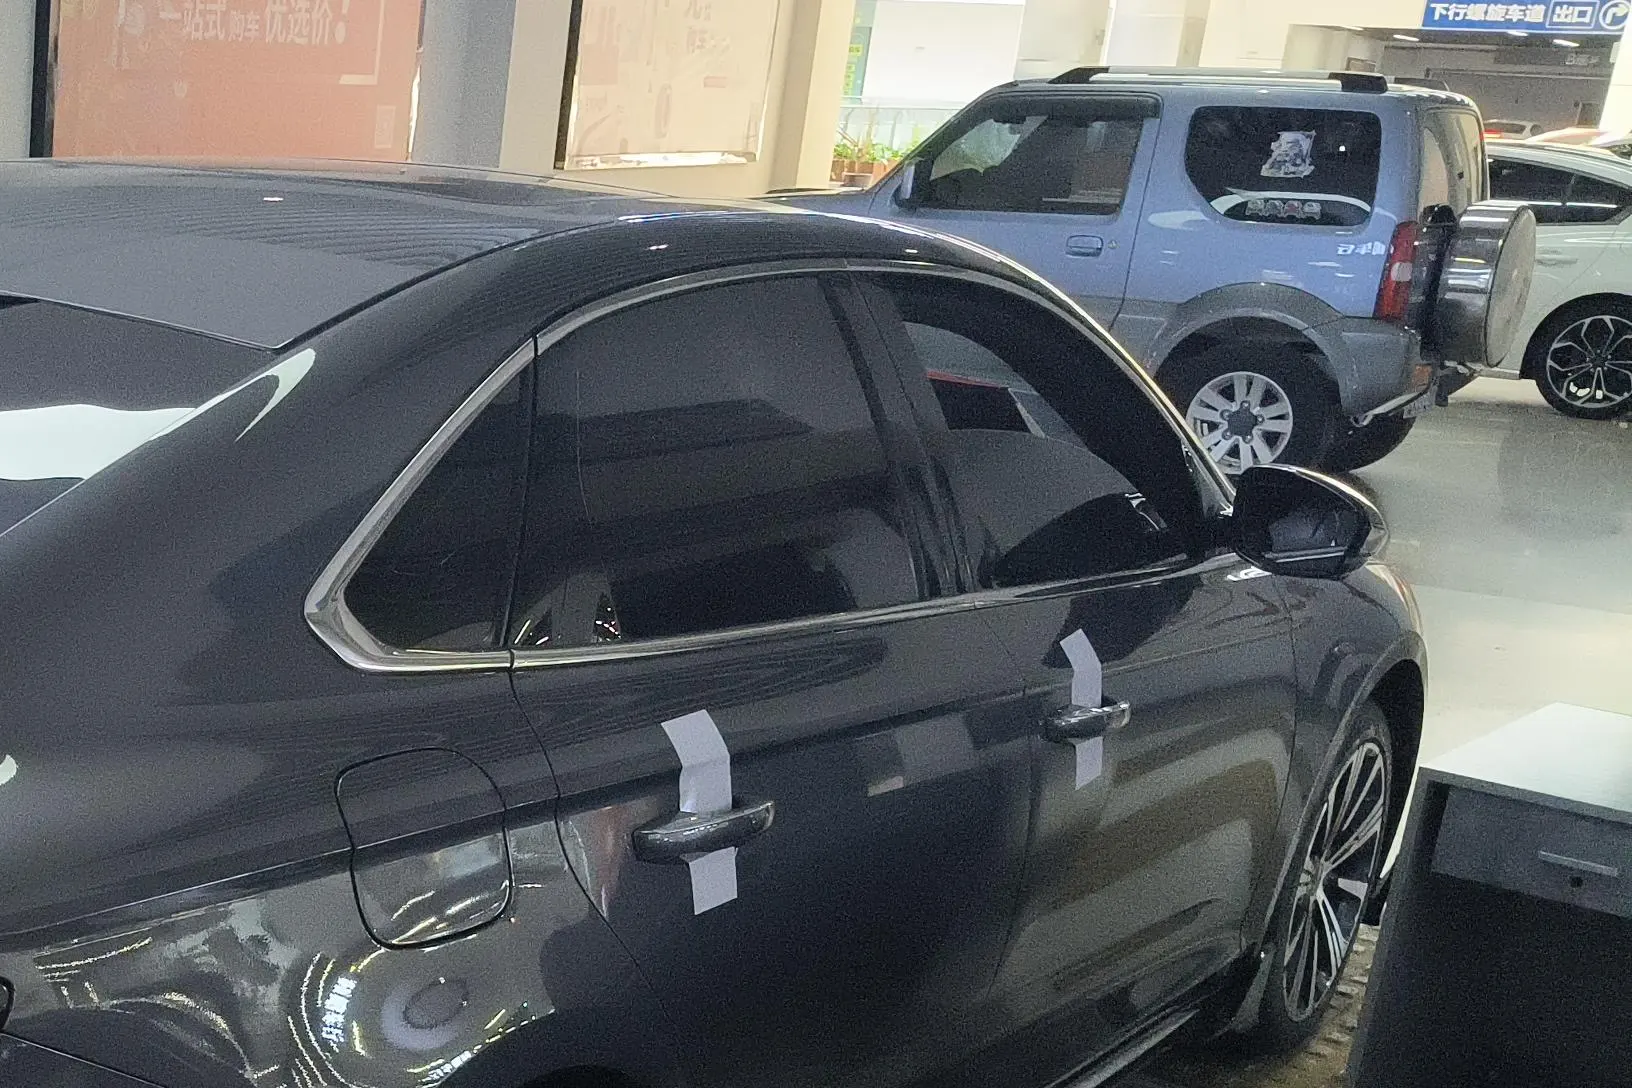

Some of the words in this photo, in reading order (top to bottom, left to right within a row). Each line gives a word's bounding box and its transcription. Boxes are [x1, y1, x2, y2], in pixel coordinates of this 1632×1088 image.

[1430, 3, 1546, 23] 下行螺旋车道
[1552, 5, 1594, 24] 出口
